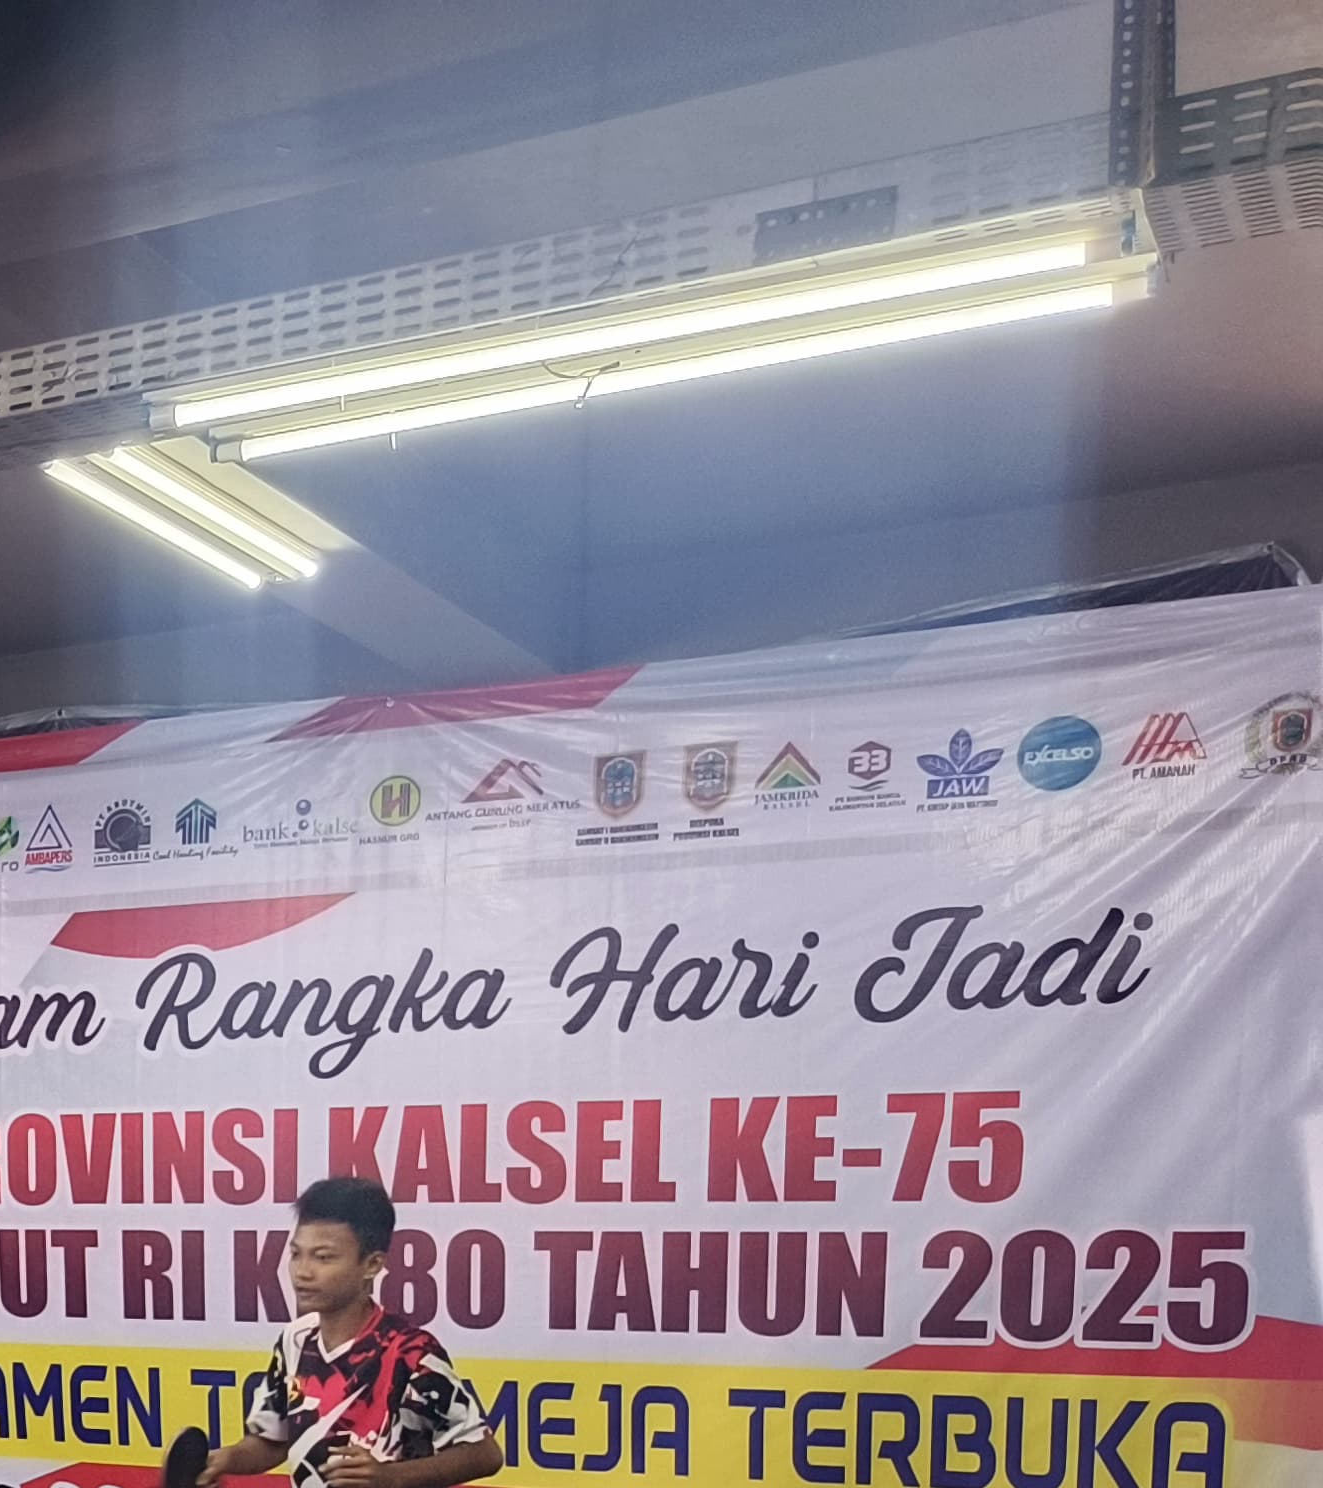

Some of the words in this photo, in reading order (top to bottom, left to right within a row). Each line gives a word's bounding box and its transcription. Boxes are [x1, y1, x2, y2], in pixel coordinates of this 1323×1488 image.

[933, 778, 985, 797] JAW
[425, 809, 473, 822] ANTANG
[25, 849, 73, 866] AMBAPERS
[93, 851, 151, 863] INDONESIA
[135, 947, 513, 1080] Rangka
[549, 922, 820, 1036] Hari
[855, 904, 1154, 1024] Jadi
[328, 1098, 677, 1205] KALSEL
[707, 1090, 1025, 1203] KE-75
[122, 1228, 207, 1323] RI
[232, 1228, 506, 1330] K80
[534, 1229, 889, 1338] TAHUN
[919, 1229, 1251, 1347] 2025
